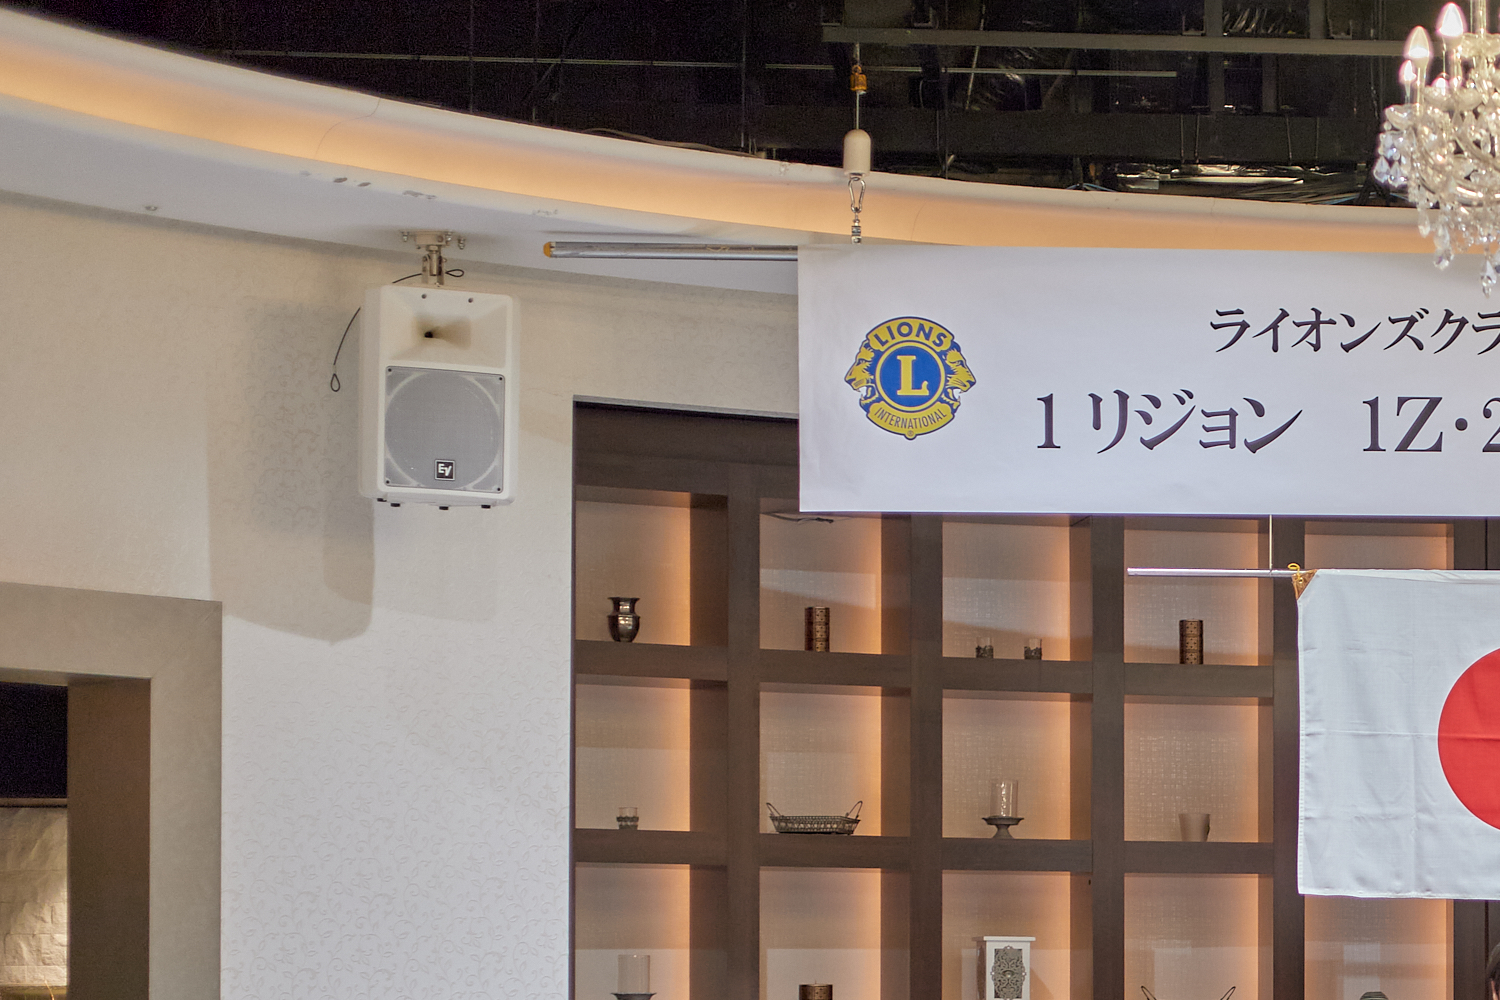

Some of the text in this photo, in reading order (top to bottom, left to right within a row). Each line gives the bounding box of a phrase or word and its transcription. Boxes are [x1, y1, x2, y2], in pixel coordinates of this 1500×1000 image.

[873, 321, 948, 348] LIONS
[896, 355, 930, 396] L
[874, 407, 947, 430] INTERNATIONAL
